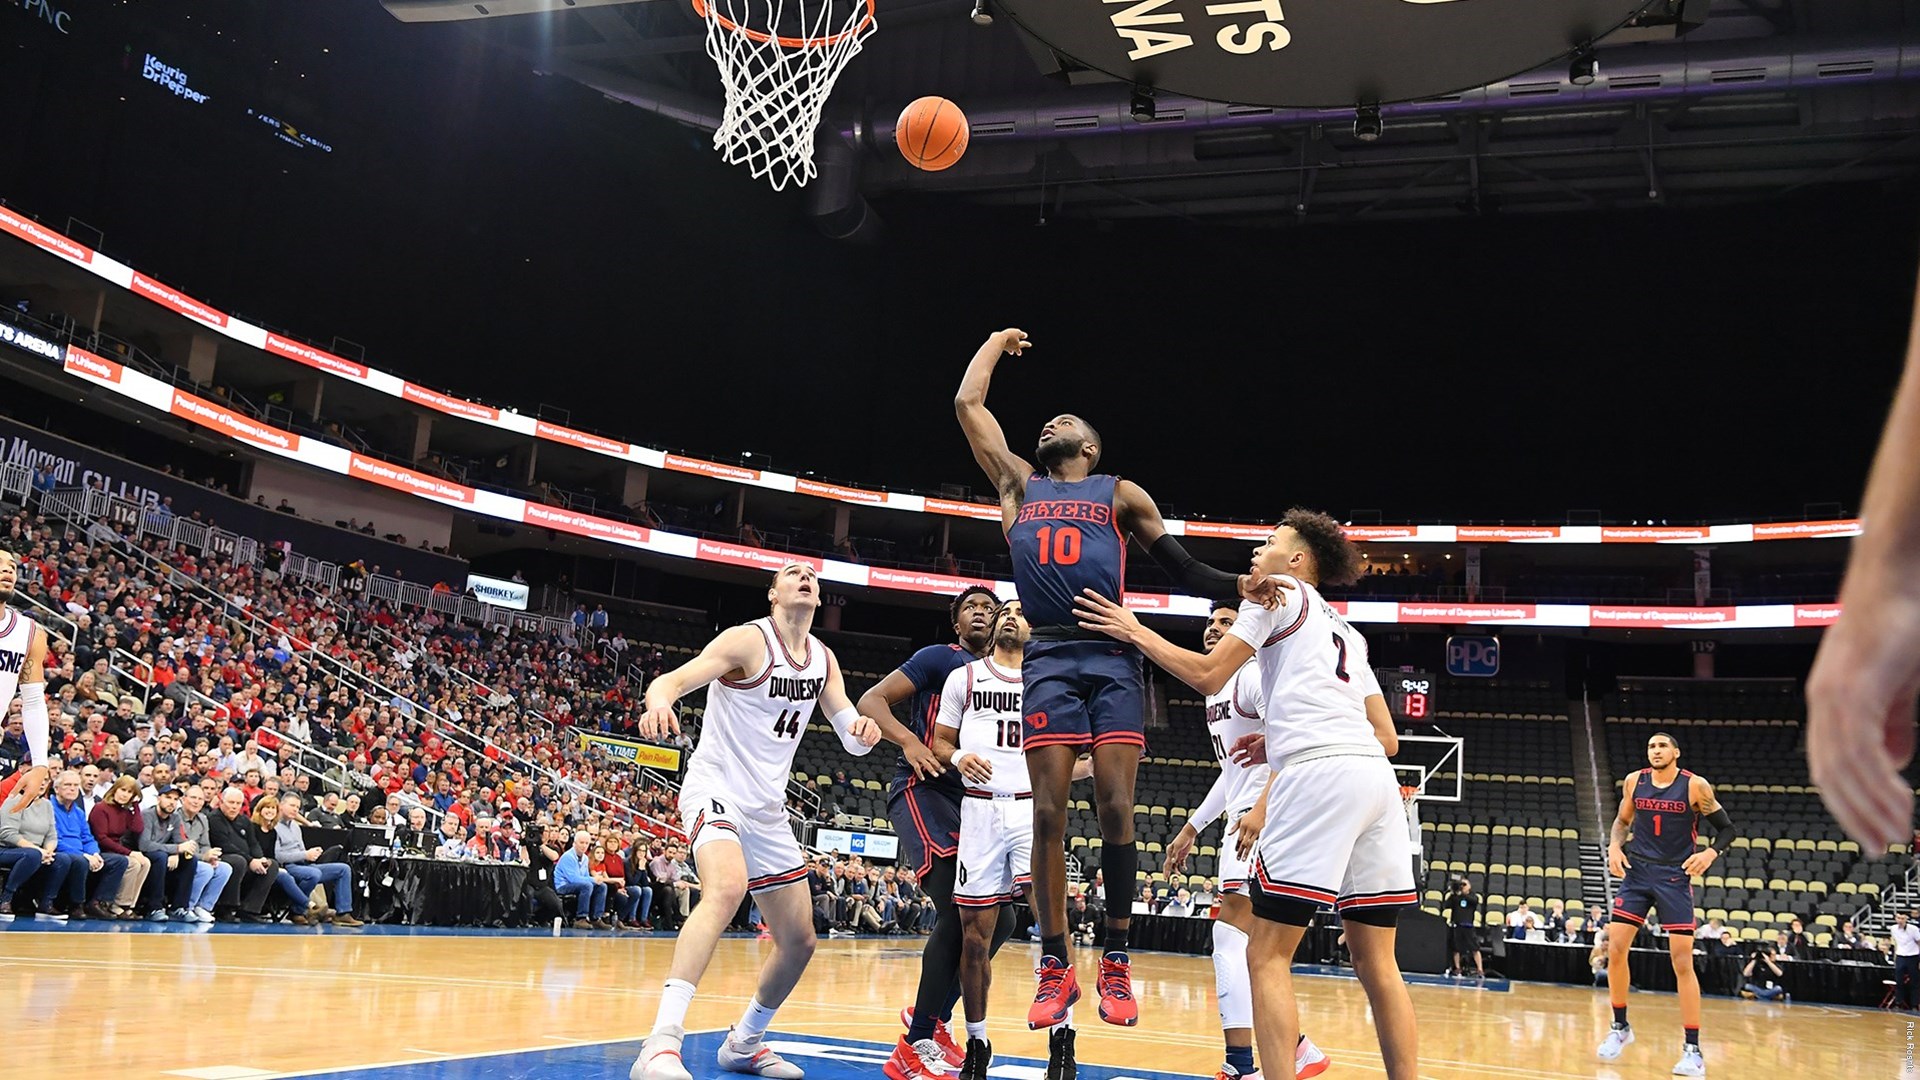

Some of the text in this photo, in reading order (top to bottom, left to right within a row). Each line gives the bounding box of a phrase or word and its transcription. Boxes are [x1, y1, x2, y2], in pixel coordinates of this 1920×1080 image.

[145, 53, 187, 85] Keurig
[114, 506, 137, 525] 114
[1018, 500, 1110, 526] FLYERS
[215, 536, 234, 555] 114
[1036, 526, 1082, 565] 10
[474, 584, 514, 599] SHORKEY
[1449, 640, 1496, 672] PPG
[769, 675, 824, 702] DUQUESNE
[1401, 680, 1430, 695] 9:42
[1404, 694, 1425, 717] 13
[773, 708, 801, 739] 44
[613, 745, 637, 759] TIME
[639, 751, 654, 761] Pain
[1635, 798, 1686, 813] FLYERS
[1652, 815, 1662, 836] 1
[852, 838, 865, 849] IGS
